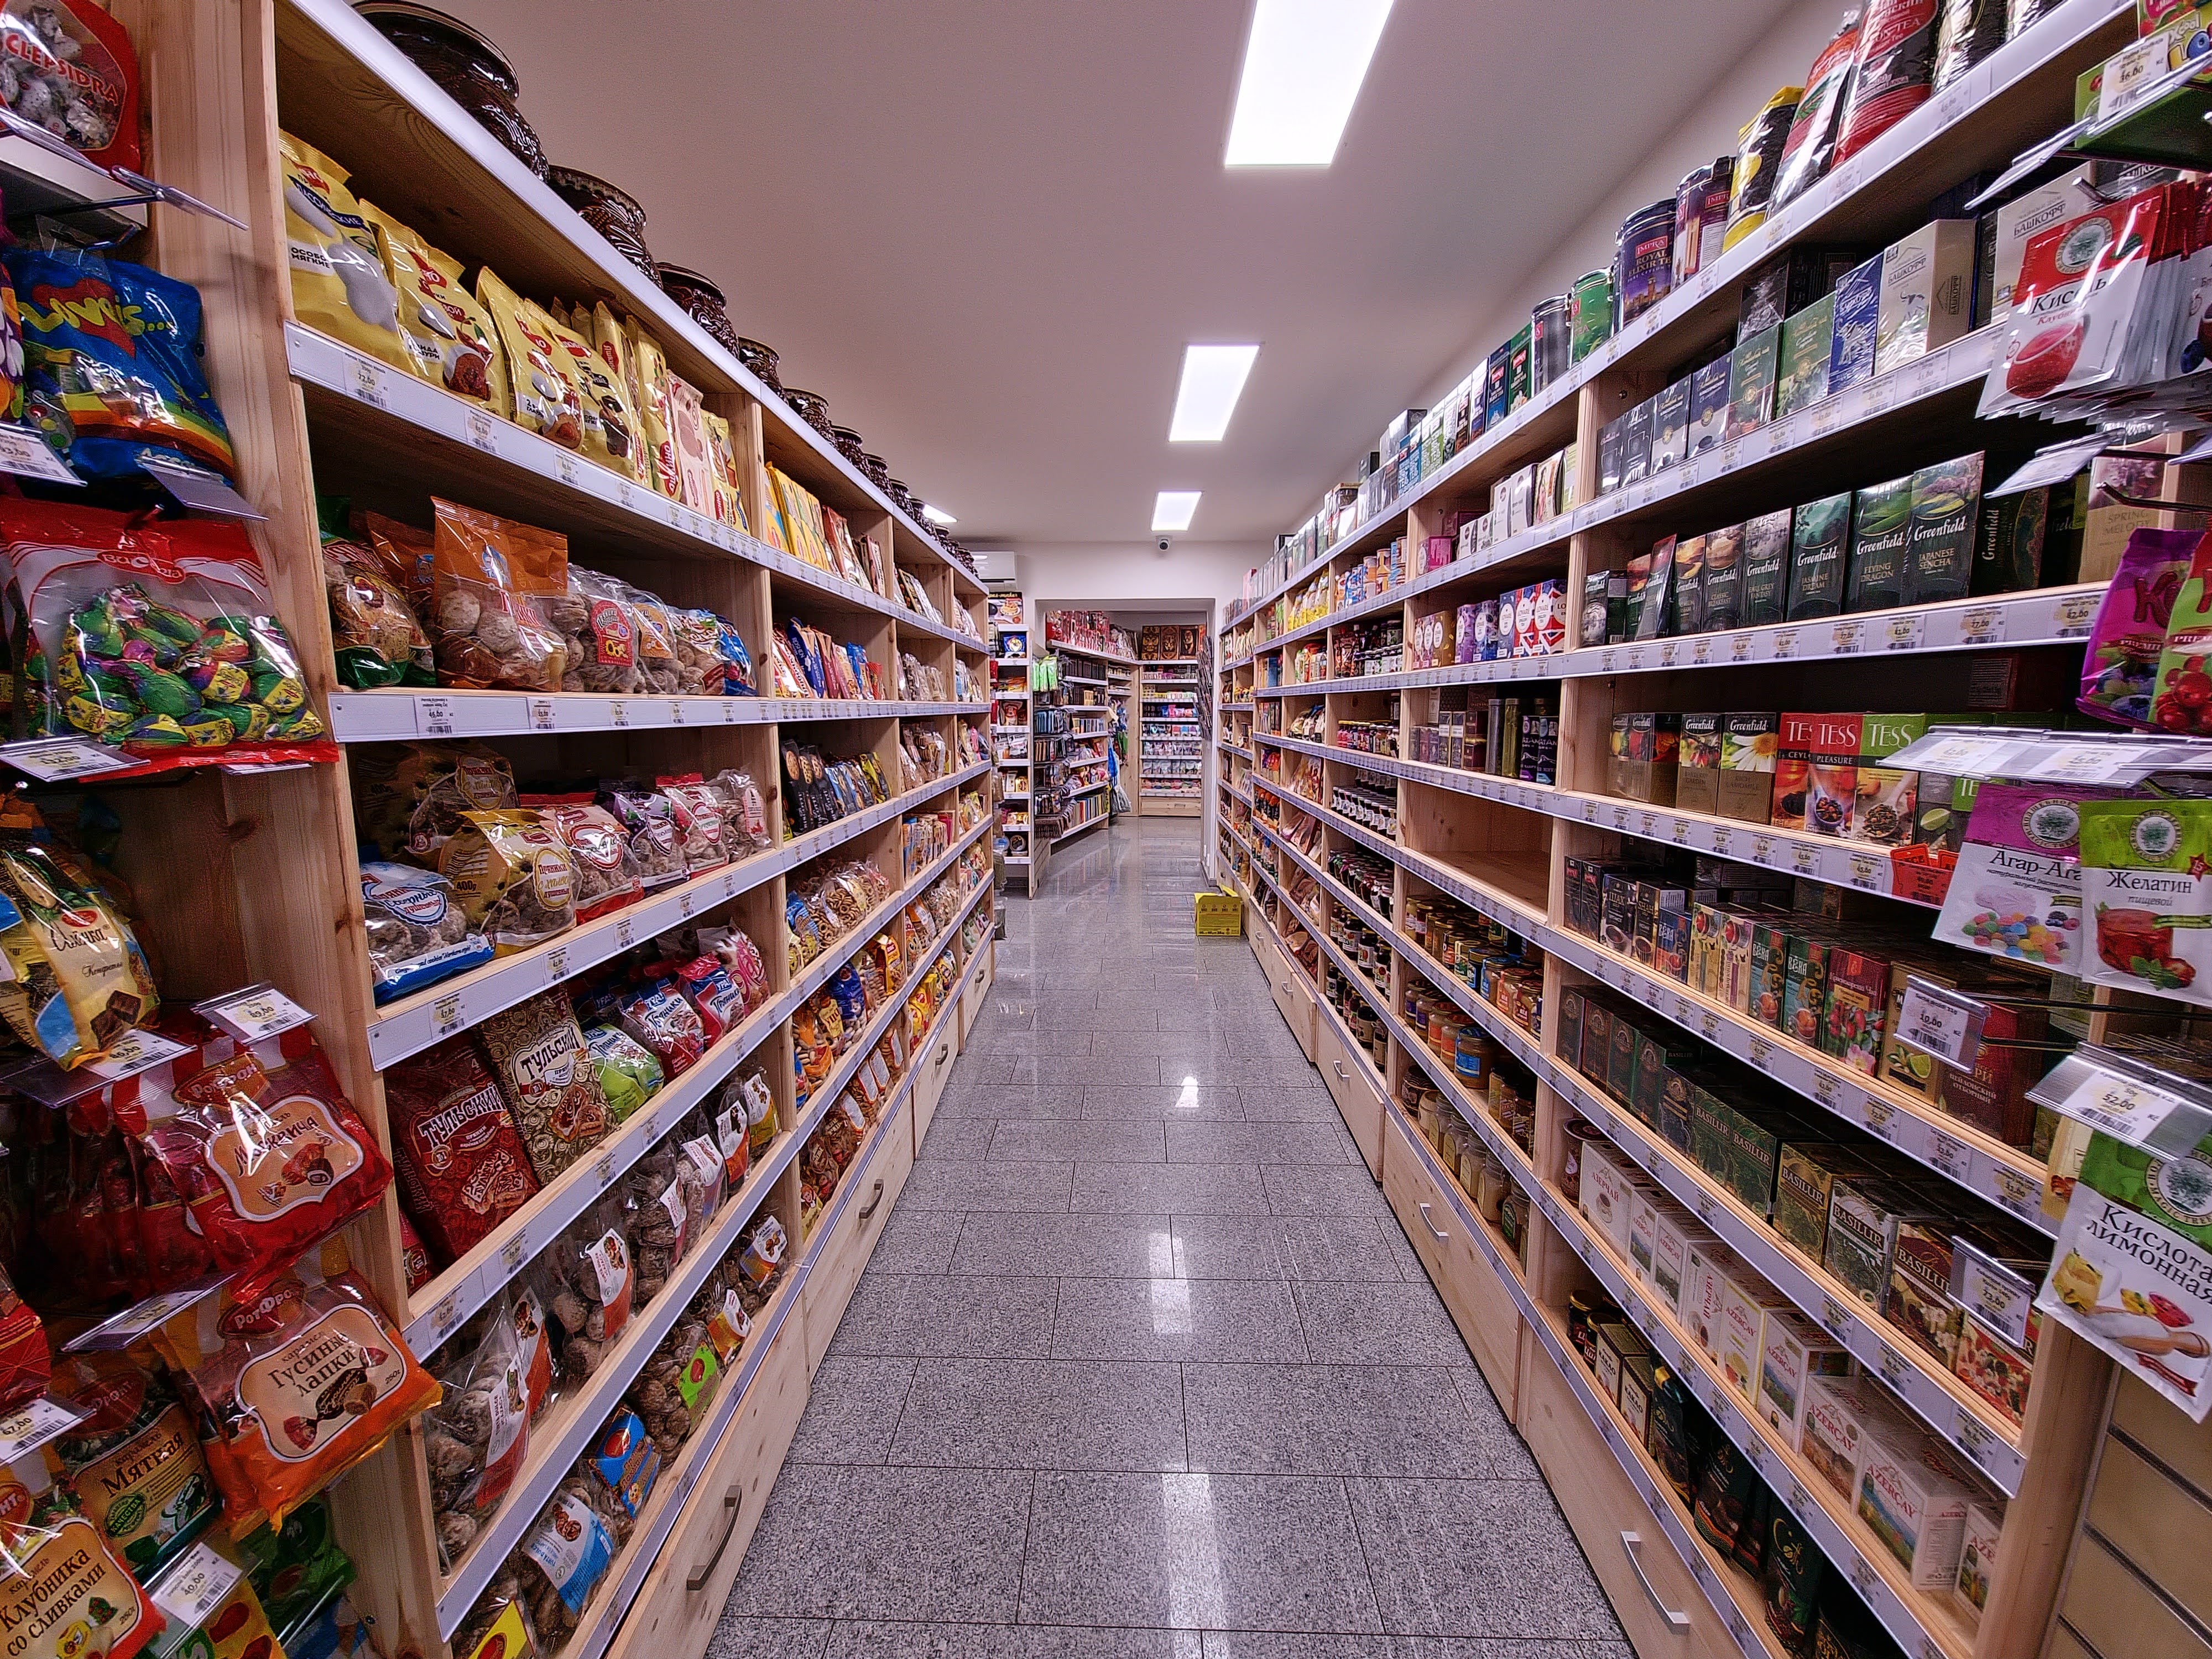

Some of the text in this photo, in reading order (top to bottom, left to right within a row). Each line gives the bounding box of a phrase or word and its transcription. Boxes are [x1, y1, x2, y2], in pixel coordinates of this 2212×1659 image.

[1895, 19, 1921, 34] TEA
[6, 32, 119, 107] CLEPSIDRA
[2013, 205, 2065, 236] БАШКОФФ
[291, 247, 326, 261] ОСОБО
[1636, 237, 1667, 254] IMPRA
[292, 254, 330, 269] МЯГКИЕ
[1627, 260, 1657, 276] ELIXIR
[1636, 251, 1667, 265] ROYAL
[1888, 258, 1927, 284] БАШКОФФ
[2107, 509, 2149, 525] SPRING
[1914, 515, 1966, 542] Greenfield
[1982, 509, 2000, 561] Greenfield
[1856, 531, 1905, 555] Greenfield
[1797, 545, 1838, 567] Greenfield
[1918, 548, 1955, 562] JAPANESE
[1918, 558, 1952, 570] SENCHA
[1707, 568, 1736, 586] Greenfield
[1747, 558, 1781, 577] Greenfield
[1860, 570, 1894, 583] DRAGON
[1864, 562, 1891, 575] FLYING
[1802, 581, 1825, 592] DREAM
[791, 637, 806, 659] ROSHEN
[1685, 719, 1716, 730] Greenfield
[1730, 719, 1768, 732] Greenfield
[1818, 723, 1857, 747] TESS
[1869, 723, 1912, 749] TESS
[1817, 755, 1853, 765] PLEASURE
[2107, 870, 2192, 894] Желатин
[1637, 900, 1654, 913] SHAH
[2128, 895, 2173, 907] пищевой
[648, 996, 683, 1027] Пряники
[1919, 1013, 1943, 1027] 10,00
[520, 1025, 582, 1080] ТУЛЬСКИЙ
[1952, 1083, 1992, 1104] ОТБОРНЫЙ
[2103, 1093, 2136, 1110] 52,00
[2125, 1088, 2138, 1097] 50g
[420, 1083, 506, 1151] ТУЛЬСКИЙ
[1695, 1108, 1729, 1138] BASILUR
[1733, 1133, 1770, 1164] BASILUR
[1591, 1172, 1620, 1203] АЗЕРЧАЙ
[1782, 1168, 1824, 1205] BASILUR
[1634, 1217, 1652, 1239] AZERÇAY
[1833, 1206, 1882, 1245] BASILUR
[1659, 1237, 1681, 1260] AZERÇAY
[1725, 1306, 1756, 1337] AZERÇAY
[298, 1346, 357, 1399] лапки
[1766, 1345, 1797, 1378] AZERÇAY
[2, 1417, 32, 1436] 67,00
[1808, 1403, 1855, 1452] AZERÇAY
[101, 1432, 184, 1497] Мятная
[1867, 1467, 1917, 1520] AZERÇAY
[0, 1547, 91, 1632] Клубника
[182, 1572, 206, 1597] 40,00
[29, 1562, 107, 1641] сливками
